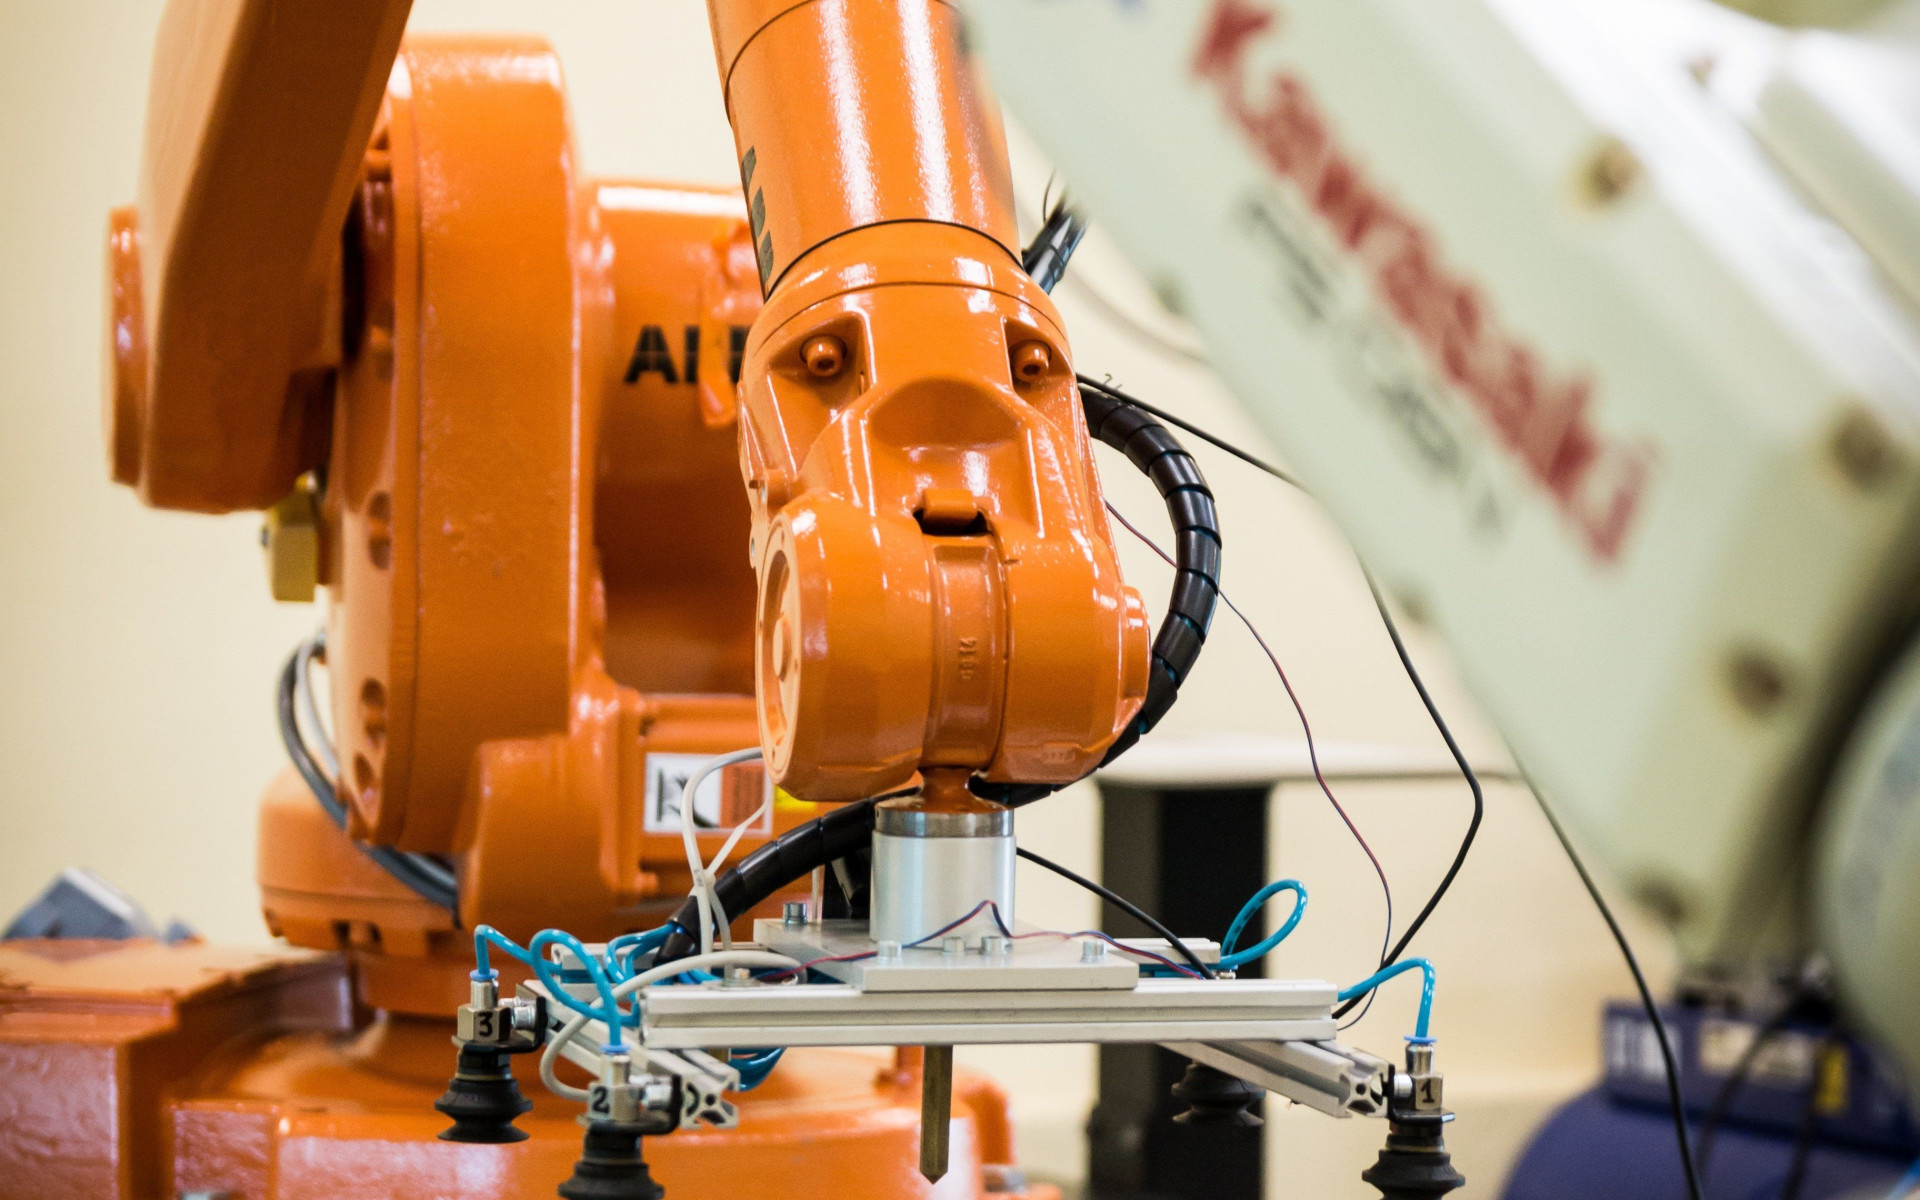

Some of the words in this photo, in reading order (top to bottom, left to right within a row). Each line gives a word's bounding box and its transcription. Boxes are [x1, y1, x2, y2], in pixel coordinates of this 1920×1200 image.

[477, 1011, 494, 1037] 3
[593, 1086, 610, 1114] 2
[1421, 1078, 1435, 1103] 1
